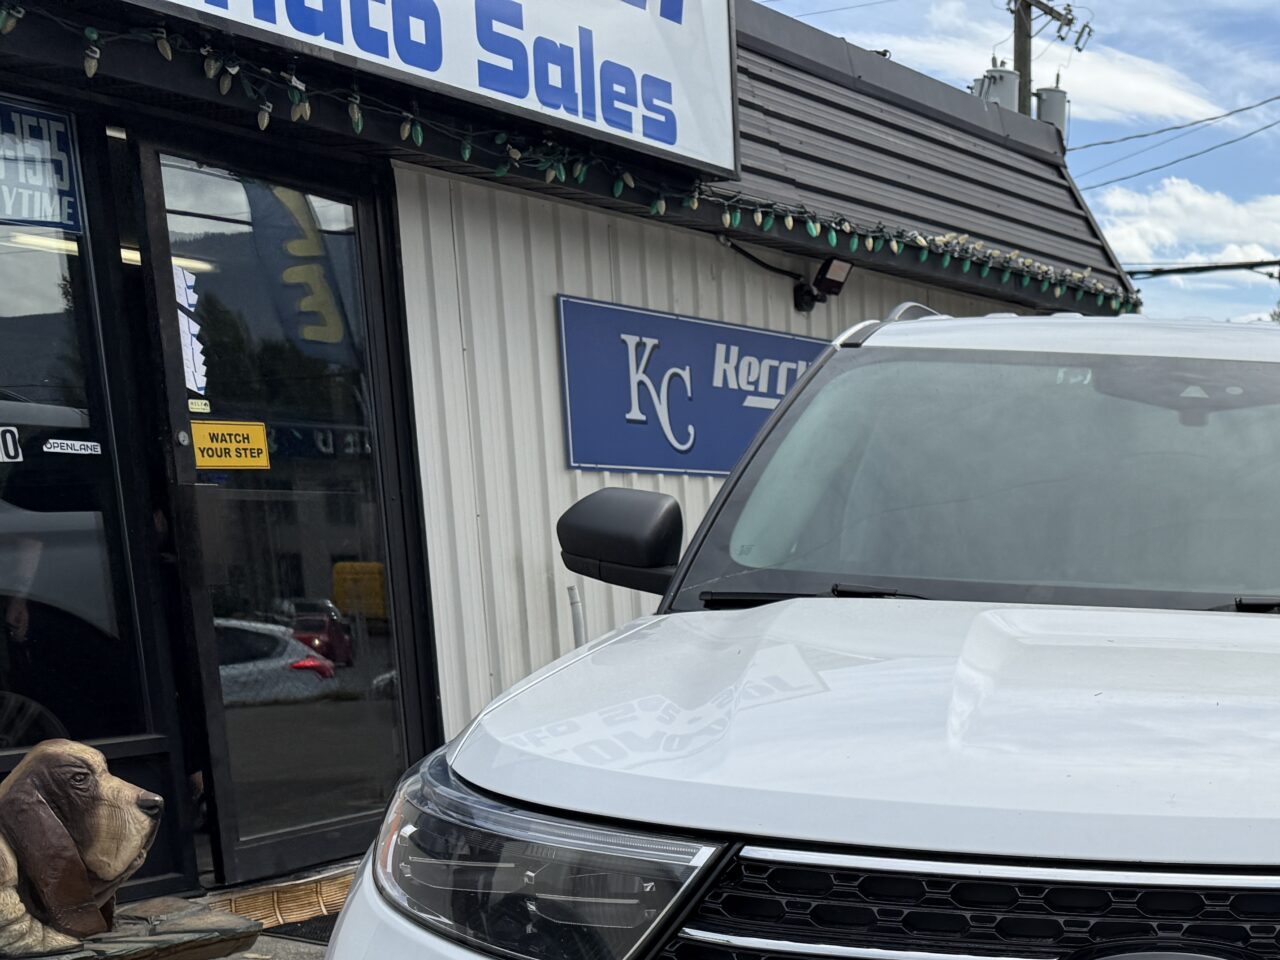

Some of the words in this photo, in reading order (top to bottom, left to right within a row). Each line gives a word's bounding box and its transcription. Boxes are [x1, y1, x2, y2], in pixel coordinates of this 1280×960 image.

[202, 0, 443, 73] uto
[475, 0, 678, 146] Sales
[620, 333, 695, 451] KC
[208, 432, 250, 444] WATCH
[45, 441, 99, 453] OPENLANE
[199, 447, 233, 459] YOUR
[235, 447, 264, 459] STEP
